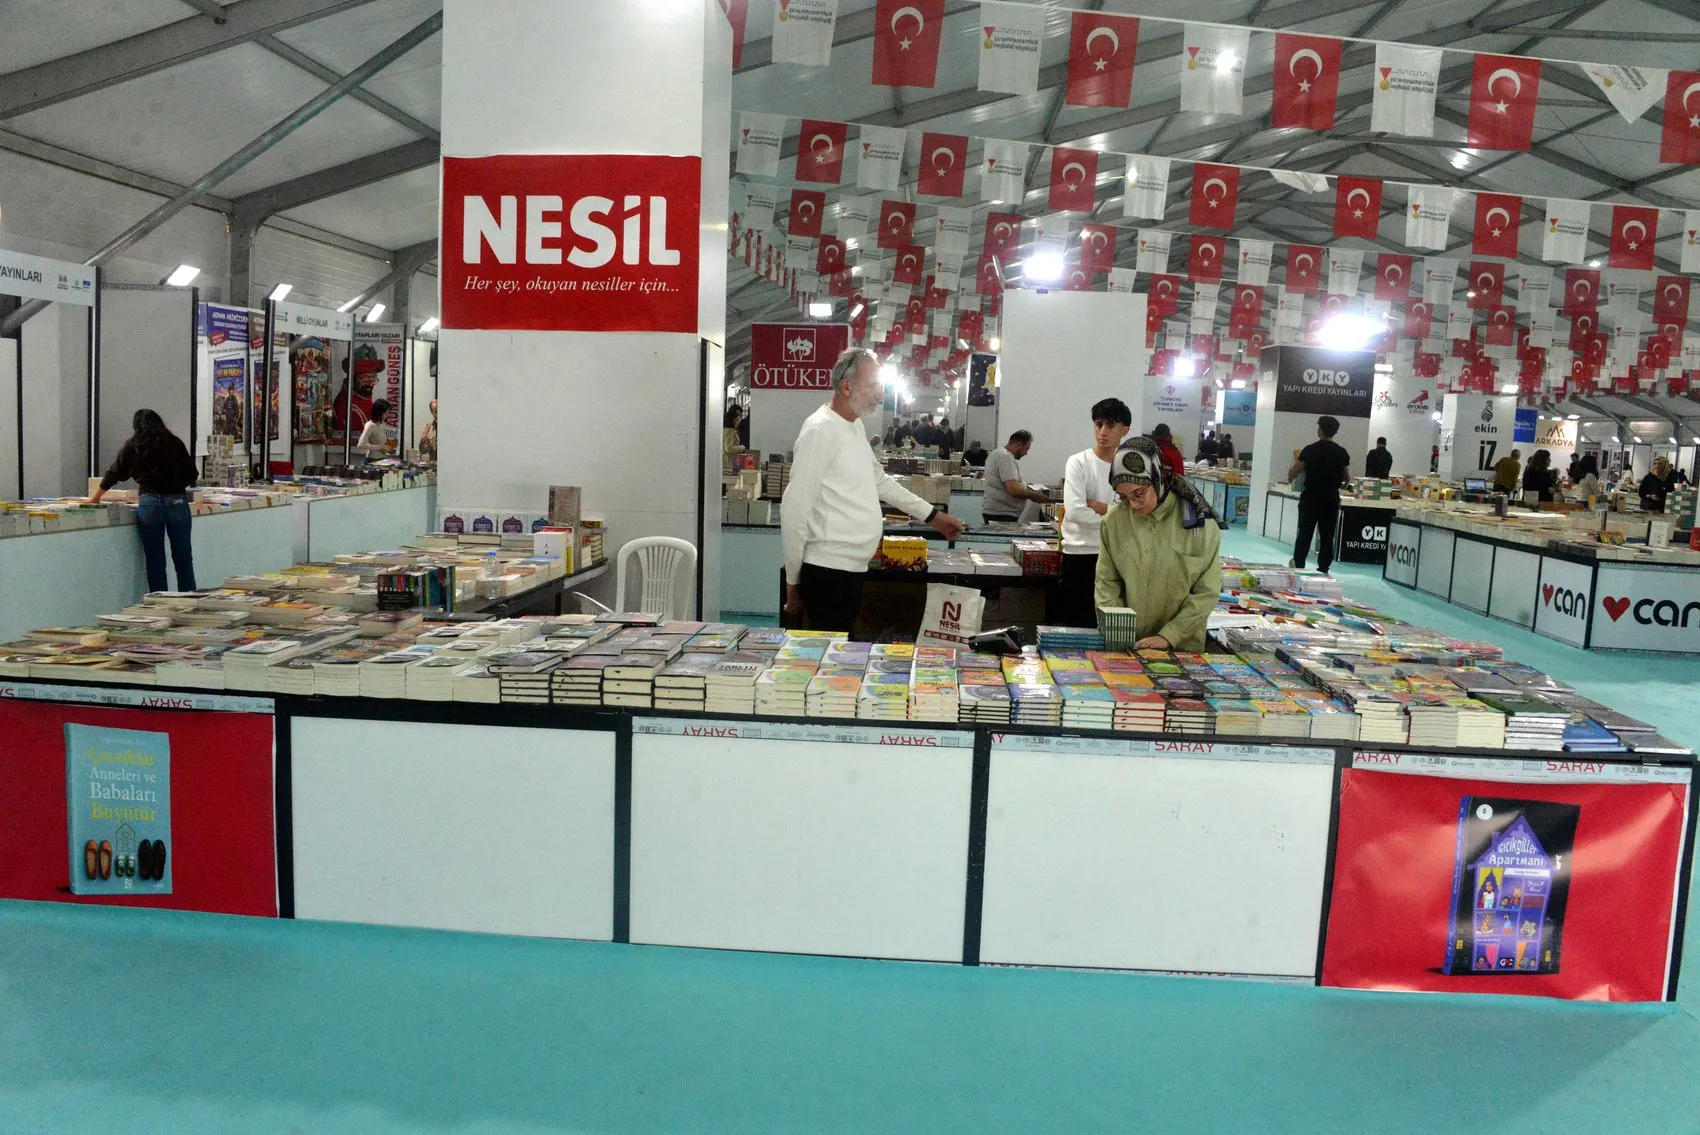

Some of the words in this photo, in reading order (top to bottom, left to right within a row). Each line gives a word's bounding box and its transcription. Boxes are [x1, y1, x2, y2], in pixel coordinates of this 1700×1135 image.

[464, 276, 492, 291] Her
[495, 279, 521, 294] şey,
[526, 276, 577, 293] okuyan
[581, 277, 635, 291] nesiller
[639, 278, 680, 294] için...
[1304, 371, 1349, 385] YKY
[1283, 384, 1300, 393] YAPI
[1327, 388, 1367, 398] YAYINLARI
[1475, 424, 1498, 434] ekin
[1346, 541, 1360, 549] YAPI
[1396, 543, 1416, 568] can
[1554, 587, 1586, 620] can
[682, 726, 739, 739] SARAY
[879, 735, 937, 747] SARAY
[1154, 741, 1215, 754] SARAY
[1546, 759, 1606, 774] SARAY
[89, 767, 141, 782] Anneleri
[144, 773, 157, 783] ve
[89, 782, 157, 802] Babaları
